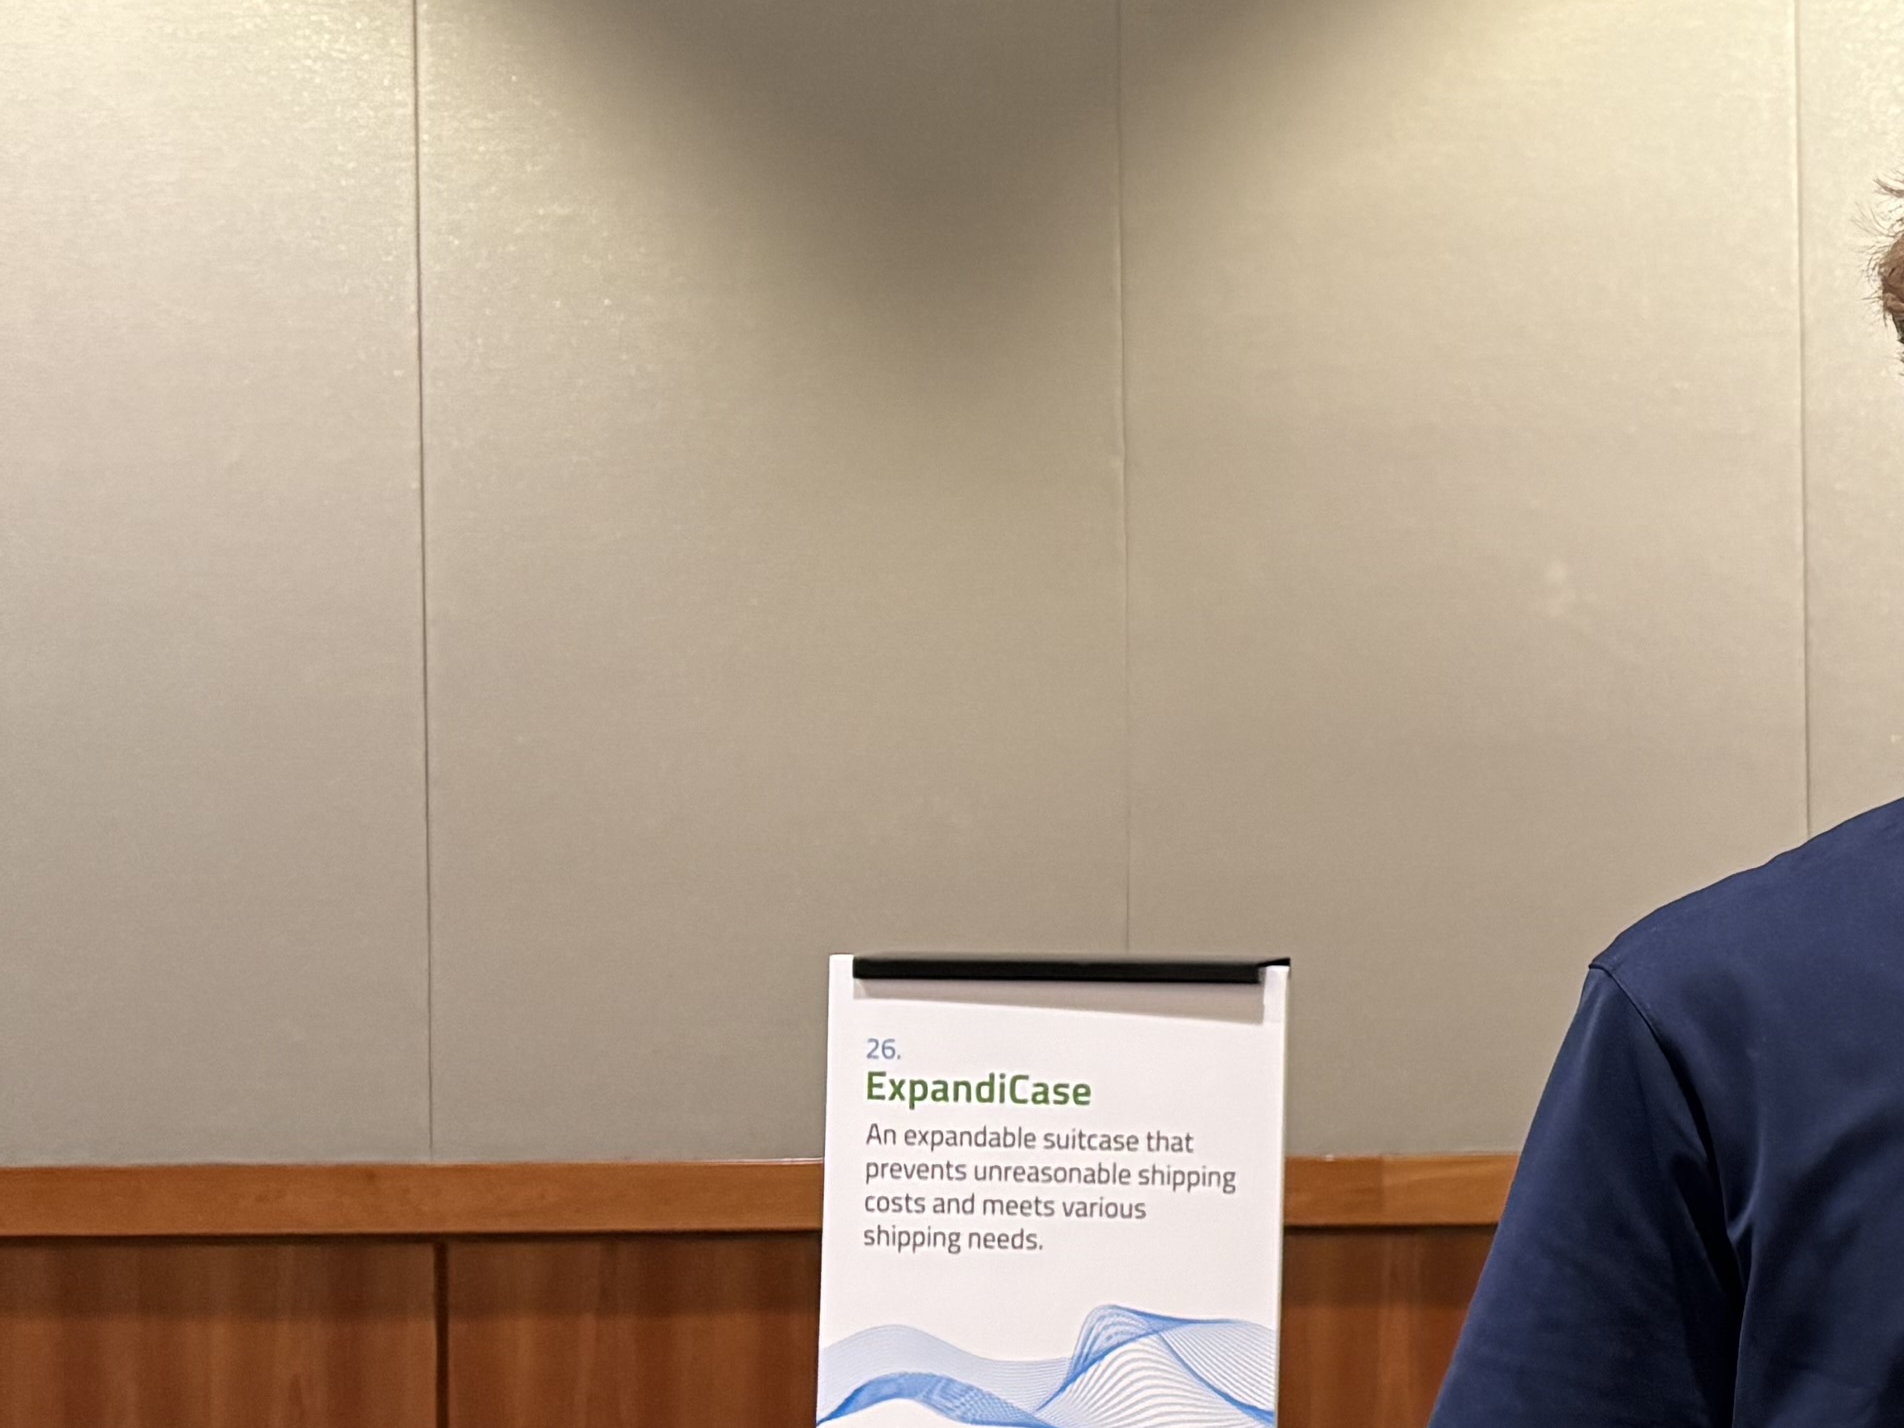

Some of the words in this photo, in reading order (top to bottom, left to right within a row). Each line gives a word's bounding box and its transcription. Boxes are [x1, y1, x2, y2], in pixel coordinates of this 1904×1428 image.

[867, 1038, 901, 1060] 26.
[867, 1071, 1091, 1110] ExpandiCase
[866, 1123, 896, 1145] An
[904, 1126, 1036, 1152] expandable
[1044, 1129, 1139, 1151] suitcase
[1147, 1130, 1193, 1153] that
[866, 1161, 966, 1184] prevents
[975, 1162, 1131, 1185] unreasonable
[1138, 1164, 1236, 1194] shipping
[865, 1193, 925, 1213] costs
[933, 1193, 974, 1214] and
[983, 1196, 1055, 1217] meets
[1062, 1197, 1146, 1219] various
[864, 1225, 961, 1254] shipping
[969, 1228, 1043, 1250] needs.
